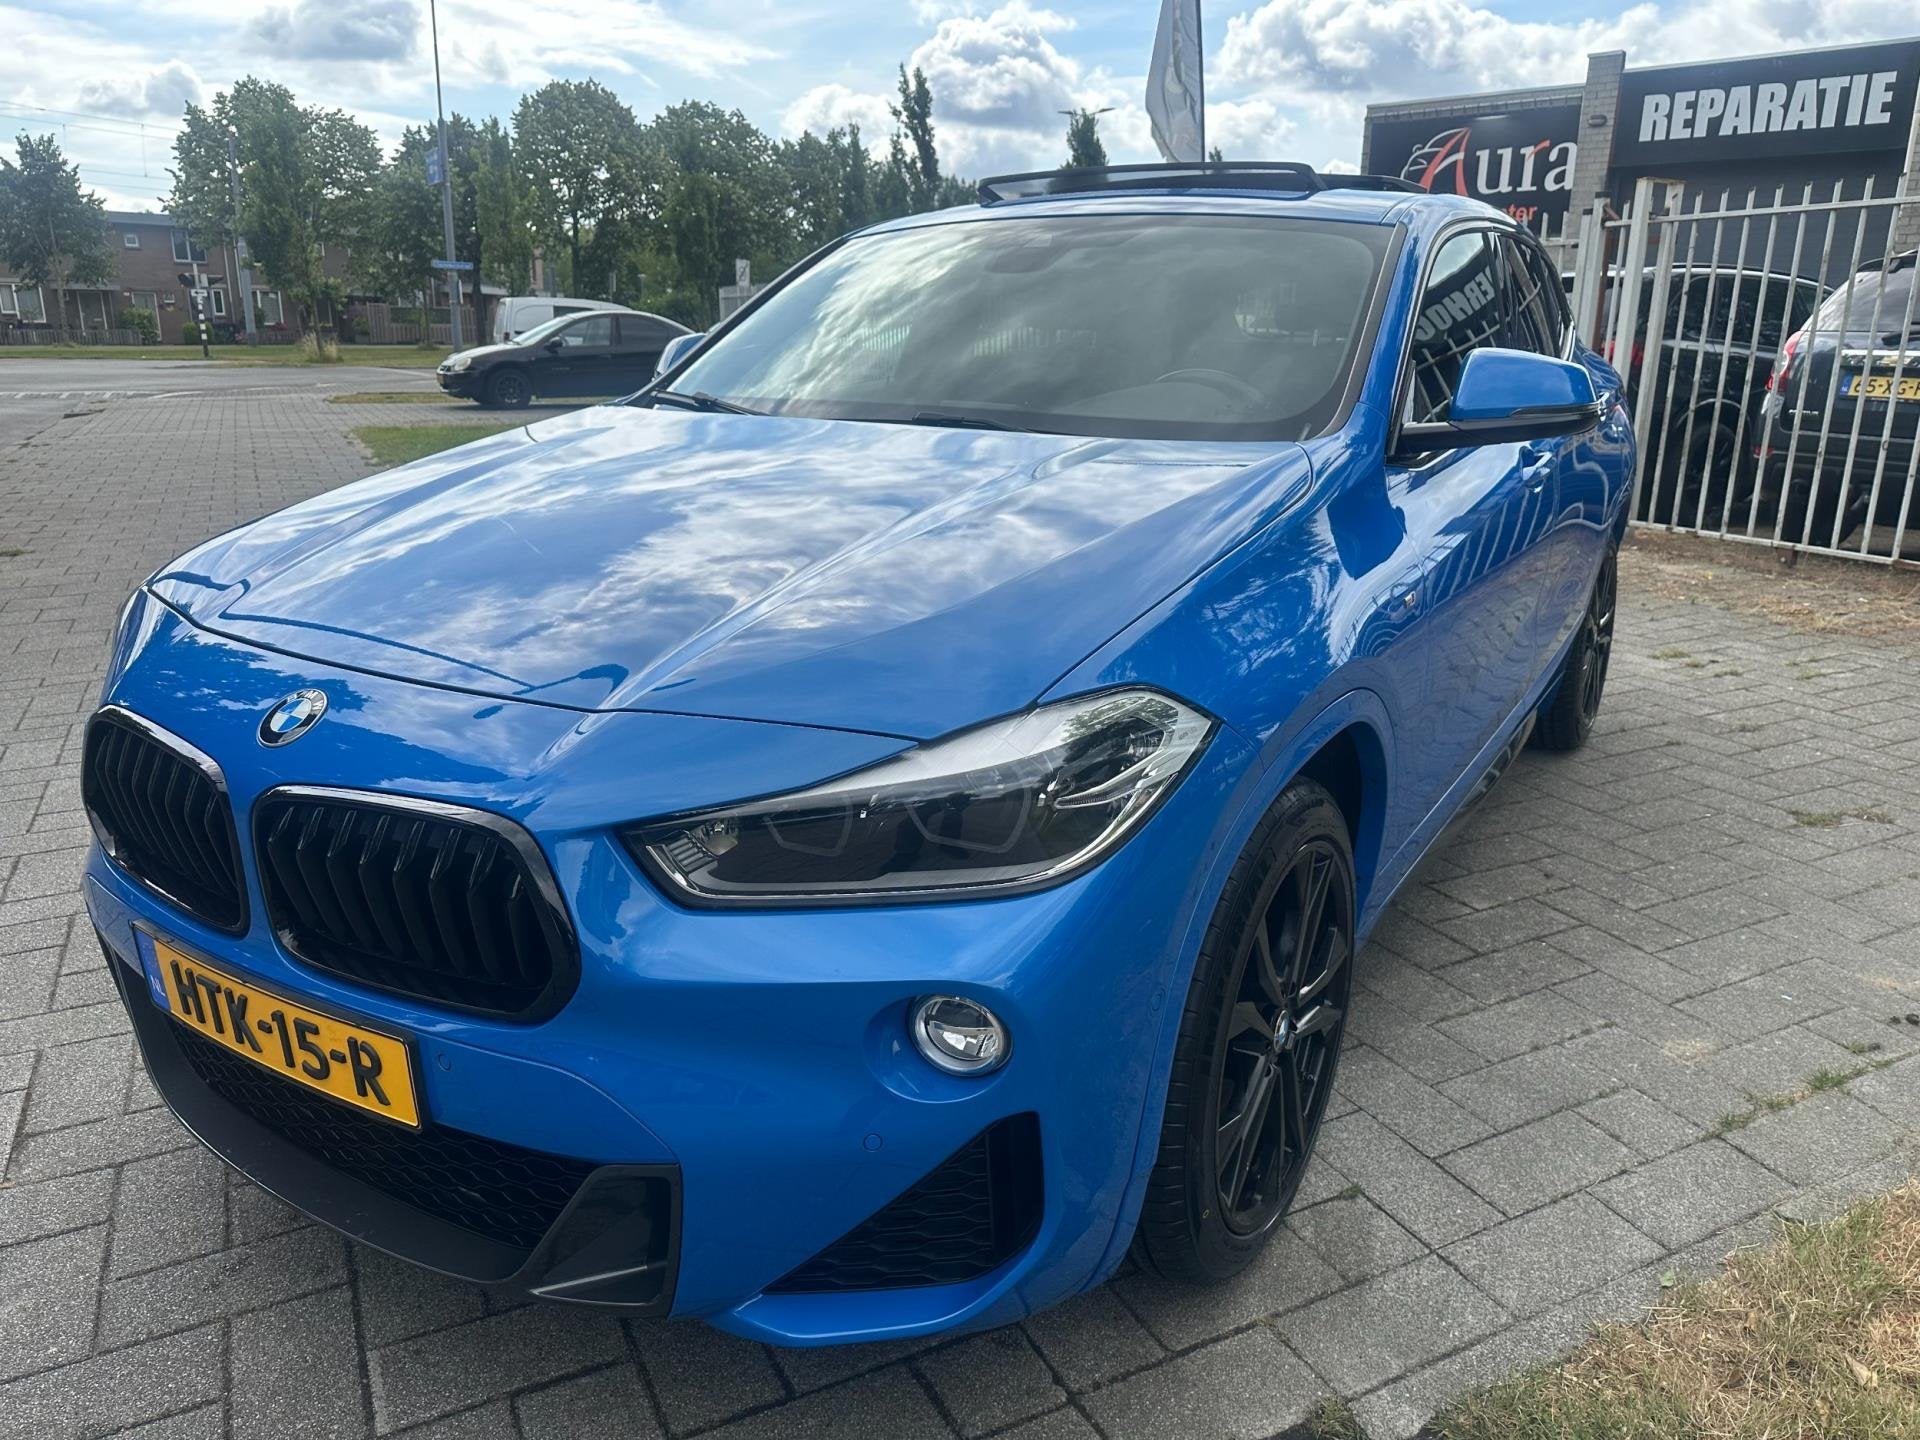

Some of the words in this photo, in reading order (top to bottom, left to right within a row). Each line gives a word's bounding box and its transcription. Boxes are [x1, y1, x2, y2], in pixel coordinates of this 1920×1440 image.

[1638, 70, 1898, 143] REPARATIE
[1418, 127, 1578, 196] Aura
[1502, 203, 1538, 224] ter
[150, 974, 166, 997] NL
[169, 959, 391, 1107] HTK-15-R
